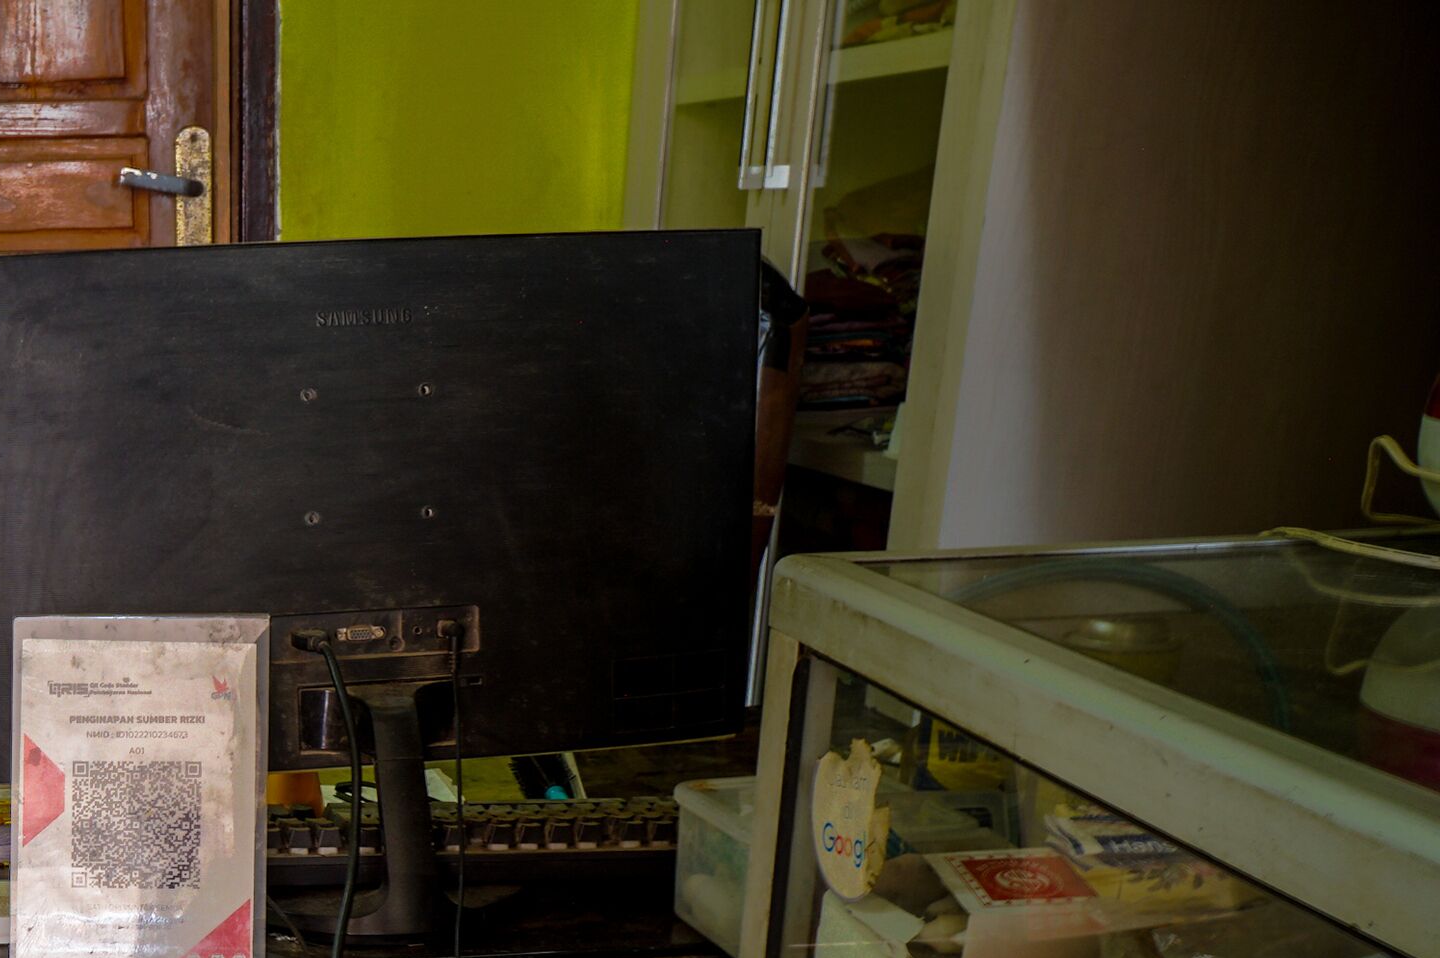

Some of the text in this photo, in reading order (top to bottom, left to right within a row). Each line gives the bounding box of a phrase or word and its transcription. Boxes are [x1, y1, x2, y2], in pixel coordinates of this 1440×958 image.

[315, 307, 413, 328] SAMSUNG
[70, 715, 205, 724] PENGINAPAN SUMBER RIZKI
[86, 731, 110, 739] NMID
